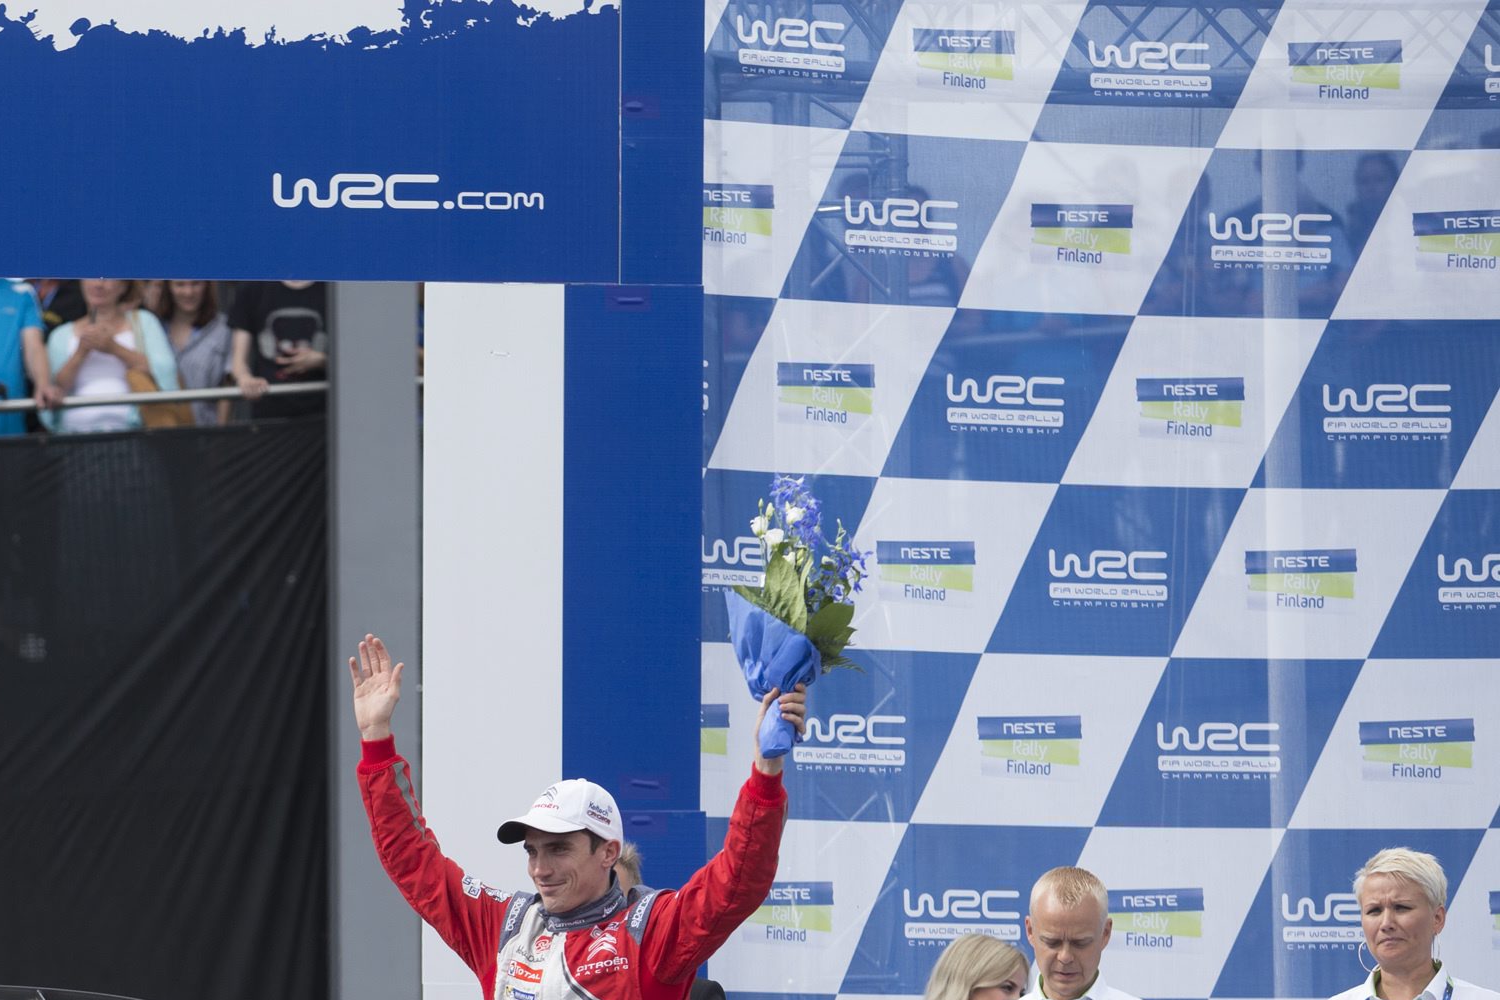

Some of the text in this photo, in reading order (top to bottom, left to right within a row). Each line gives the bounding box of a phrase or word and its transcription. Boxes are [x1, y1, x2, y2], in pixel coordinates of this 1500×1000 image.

[737, 15, 845, 51] WRC
[939, 35, 991, 49] NESTE
[1088, 40, 1211, 70] WRC
[1316, 47, 1374, 60] NESTE
[943, 72, 985, 89] Finland
[1319, 85, 1369, 100] Finland
[844, 196, 958, 229] WRC
[1057, 211, 1109, 222] NESTE
[1209, 213, 1332, 242] WRC
[1444, 216, 1500, 229] NESTE
[704, 228, 747, 245] Finland
[1057, 247, 1102, 264] Finland
[1447, 254, 1497, 269] Finland
[803, 369, 851, 381] NESTE
[946, 374, 1065, 406] WRC
[1163, 384, 1218, 396] NESTE
[1323, 384, 1451, 413] WRC
[806, 406, 847, 424] Finland
[950, 412, 1061, 423] FIA WORLD RALLY
[950, 425, 1061, 435] CHAMPIONSHIP
[1166, 420, 1212, 437] Finland
[901, 547, 950, 559] NESTE
[1049, 549, 1168, 580] WRC
[1274, 555, 1329, 568] NESTE
[904, 585, 945, 601] Finland
[1276, 593, 1324, 609] Finland
[1053, 600, 1165, 608] CHAMPIONSHIP
[1003, 722, 1056, 735] NESTE
[1157, 722, 1279, 751] WRC
[1389, 726, 1446, 739] NESTE
[1007, 760, 1051, 776] Finland
[1392, 763, 1441, 780] Finland
[904, 888, 1020, 919] WRC
[1123, 895, 1178, 908] NESTE
[766, 926, 806, 942] Finland
[1126, 932, 1173, 948] Finland
[515, 966, 541, 980] TOTAL
